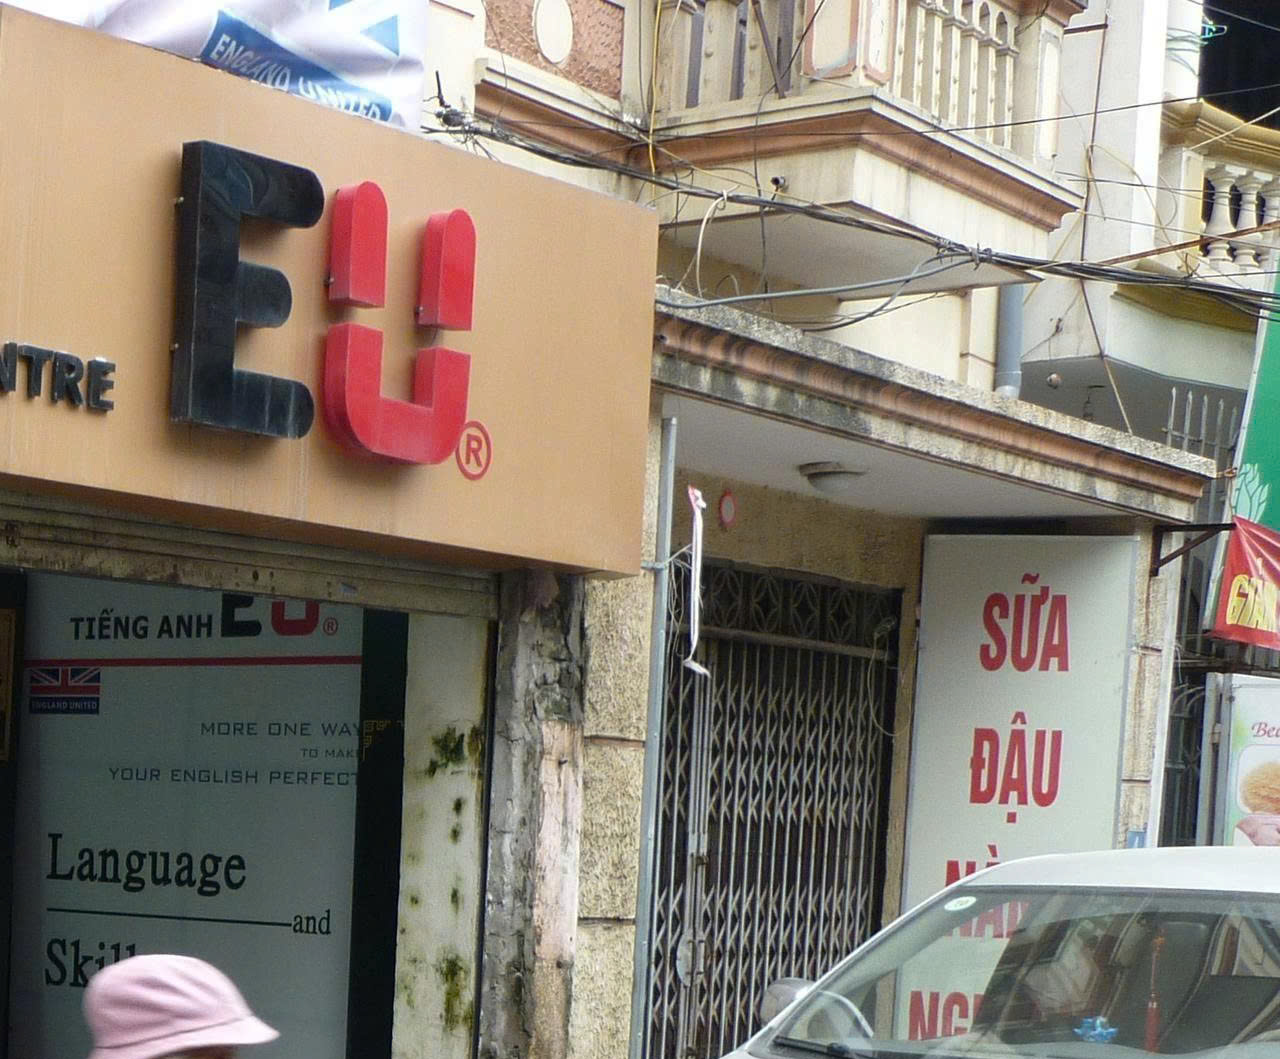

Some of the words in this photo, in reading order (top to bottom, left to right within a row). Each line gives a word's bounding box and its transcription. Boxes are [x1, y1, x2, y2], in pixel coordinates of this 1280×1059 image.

[209, 33, 291, 92] ENGLAND
[171, 140, 478, 465] EU
[70, 608, 149, 640] TIẾNG
[157, 614, 213, 639] ANH
[979, 573, 1069, 672] SỮA
[200, 722, 258, 736] MORE
[268, 722, 312, 736] ONE
[108, 767, 161, 782] YOUR
[171, 768, 258, 784] ENGLISH
[301, 748, 318, 759] TO
[969, 711, 1063, 823] ĐẬU
[45, 832, 247, 897] Language
[292, 909, 332, 936] and
